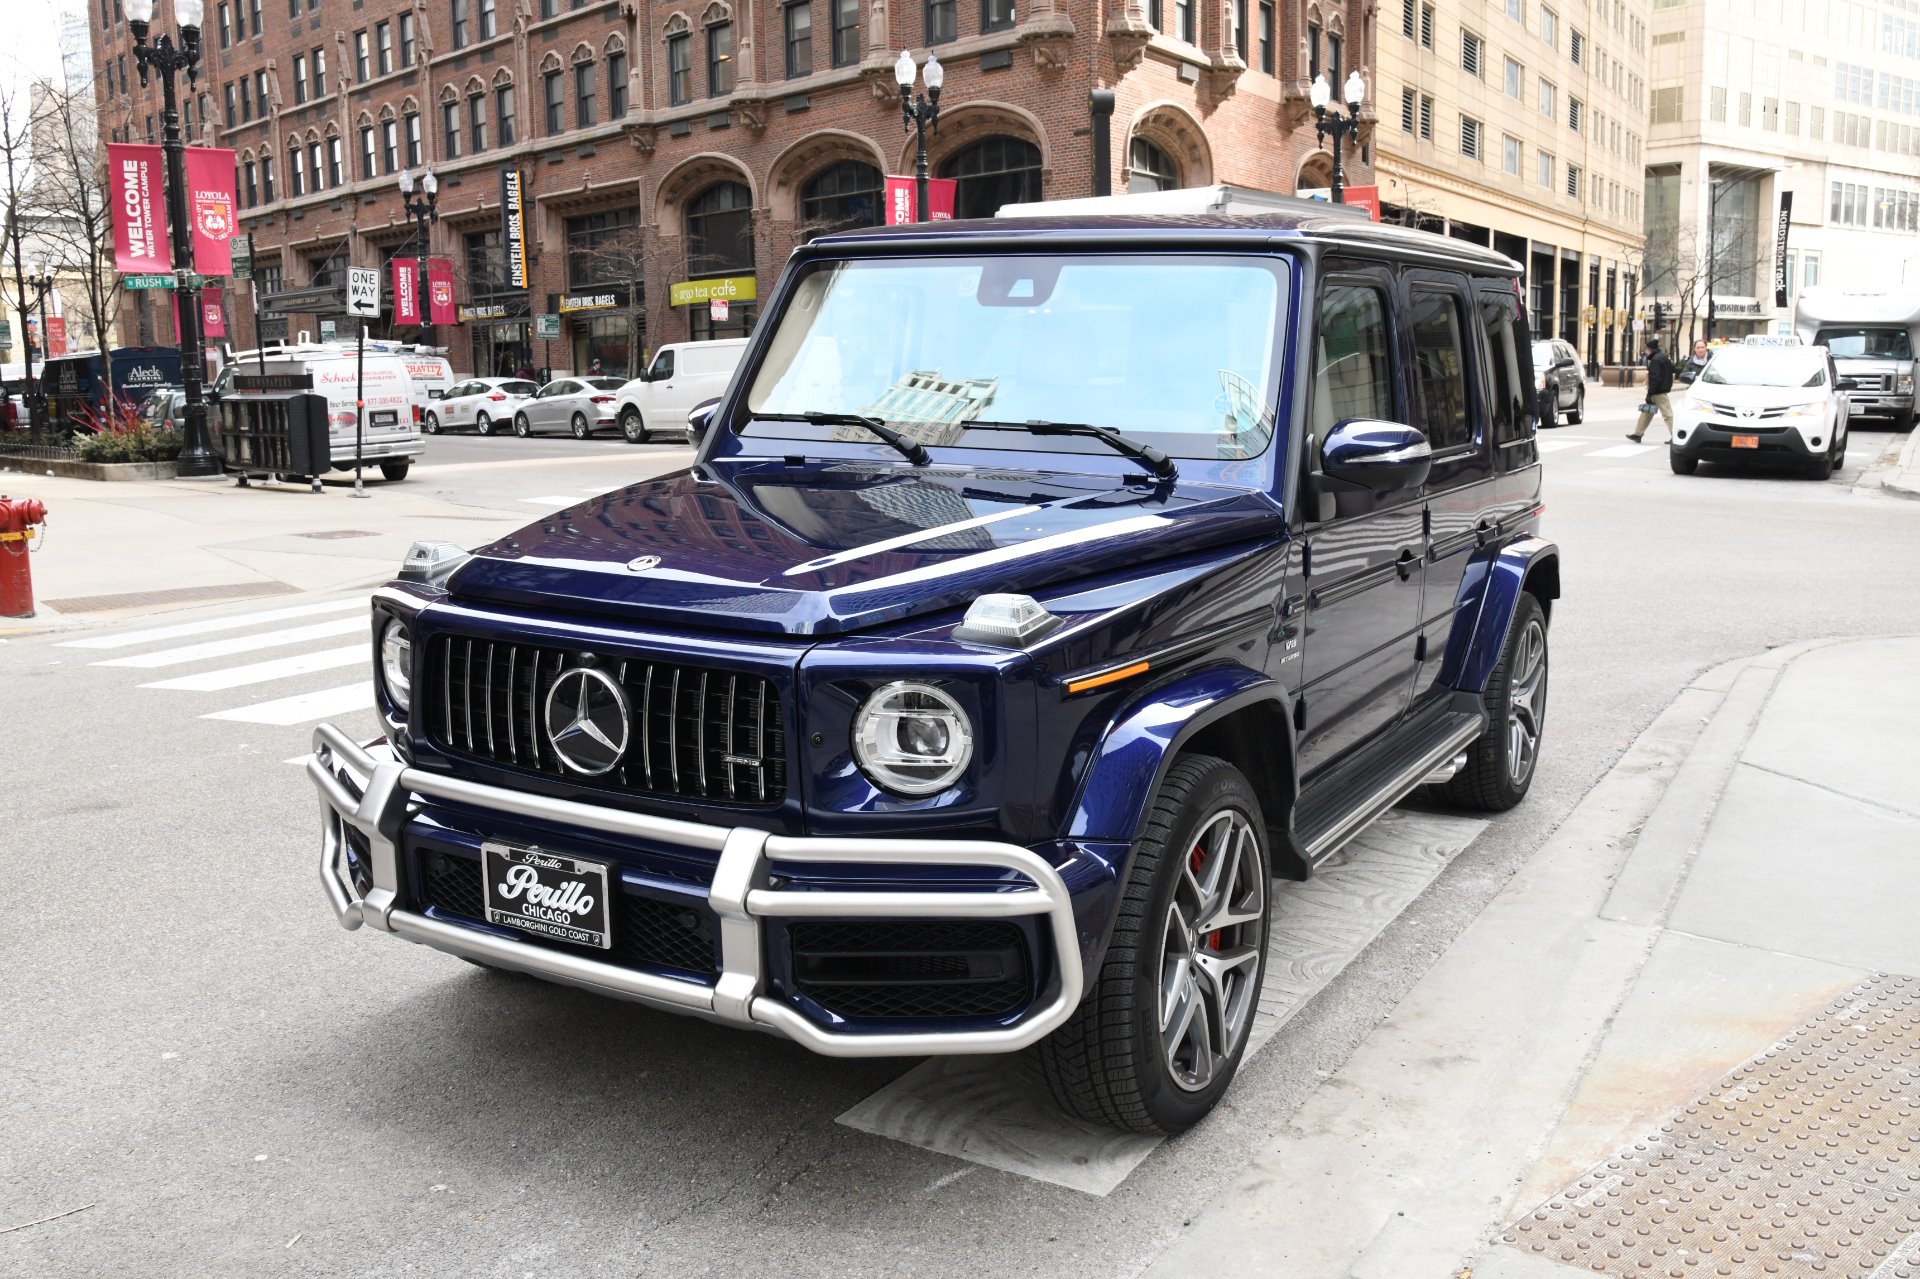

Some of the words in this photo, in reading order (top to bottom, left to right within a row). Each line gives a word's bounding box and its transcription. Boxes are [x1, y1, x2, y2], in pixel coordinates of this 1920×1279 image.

[140, 161, 150, 197] CAMPUS
[195, 191, 230, 200] LOYOLA
[506, 172, 519, 210] BAGELS
[123, 160, 146, 258] WELCOME
[142, 198, 152, 228] TOWER
[508, 213, 521, 239] BROS.
[145, 231, 155, 258] WATER
[1776, 210, 1788, 266] NORDSTROM
[510, 242, 523, 287] EINSTEIN
[135, 278, 162, 287] RUSH
[352, 272, 376, 285] ONE
[1776, 266, 1786, 292] rack
[351, 285, 376, 297] WAY
[399, 266, 410, 317] WELCOME
[565, 297, 582, 309] EINSTEIN
[594, 294, 615, 306] BAGELS
[680, 289, 694, 303] argo
[695, 286, 708, 297] tea
[711, 280, 737, 297] café
[1648, 301, 1673, 312] rck
[1760, 337, 1783, 346] 2882
[130, 365, 160, 378] Aleck
[320, 372, 356, 384] Scheck
[1285, 638, 1297, 651] V8
[522, 853, 562, 869] Perillo
[497, 864, 595, 916] Perillo
[522, 903, 571, 925] CHICAGO
[503, 915, 548, 933] LAMBORGHINI
[548, 925, 567, 937] GOLD
[568, 930, 590, 942] COAST
